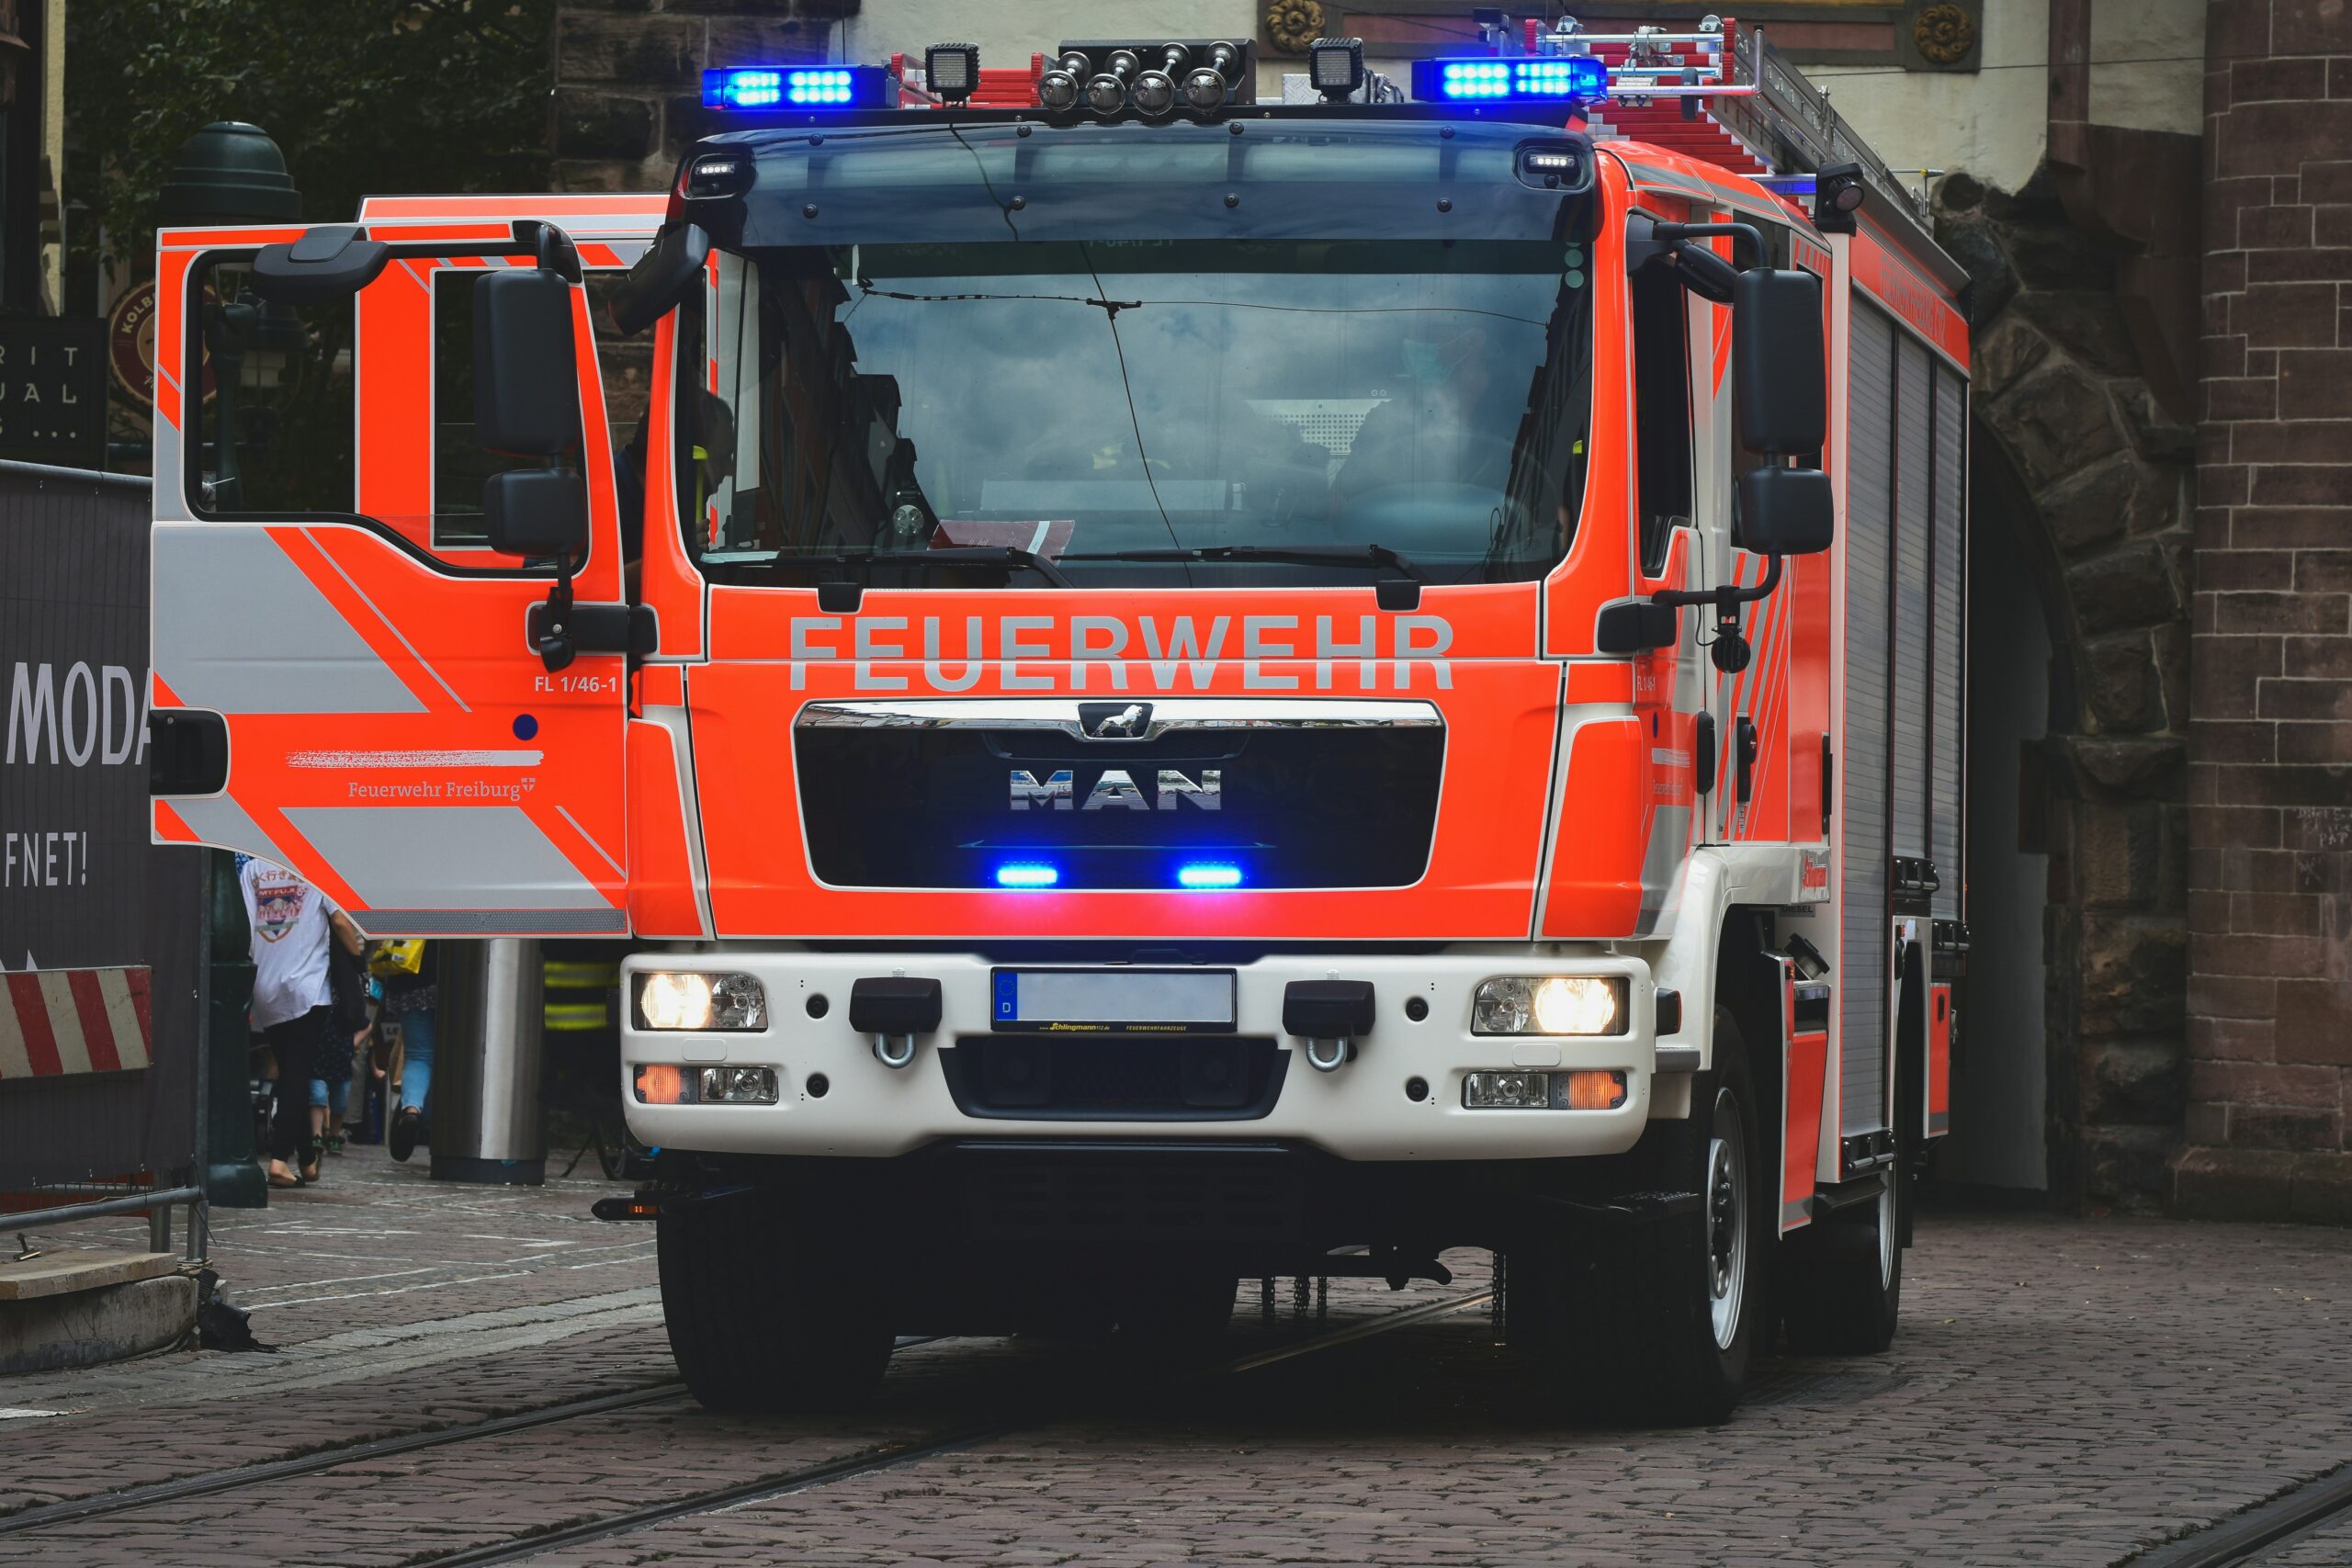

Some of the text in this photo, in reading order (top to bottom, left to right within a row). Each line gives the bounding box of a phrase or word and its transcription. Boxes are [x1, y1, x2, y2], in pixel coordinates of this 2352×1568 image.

[789, 615, 1454, 692] FEUERWEHR
[535, 676, 616, 693] FL 1/46-1
[347, 781, 521, 802] Feuerwehr Freiburg
[1010, 770, 1222, 811] MAN
[6, 831, 87, 887] FNET!
[1782, 904, 1814, 913] DIESEL
[1001, 1002, 1011, 1013] D
